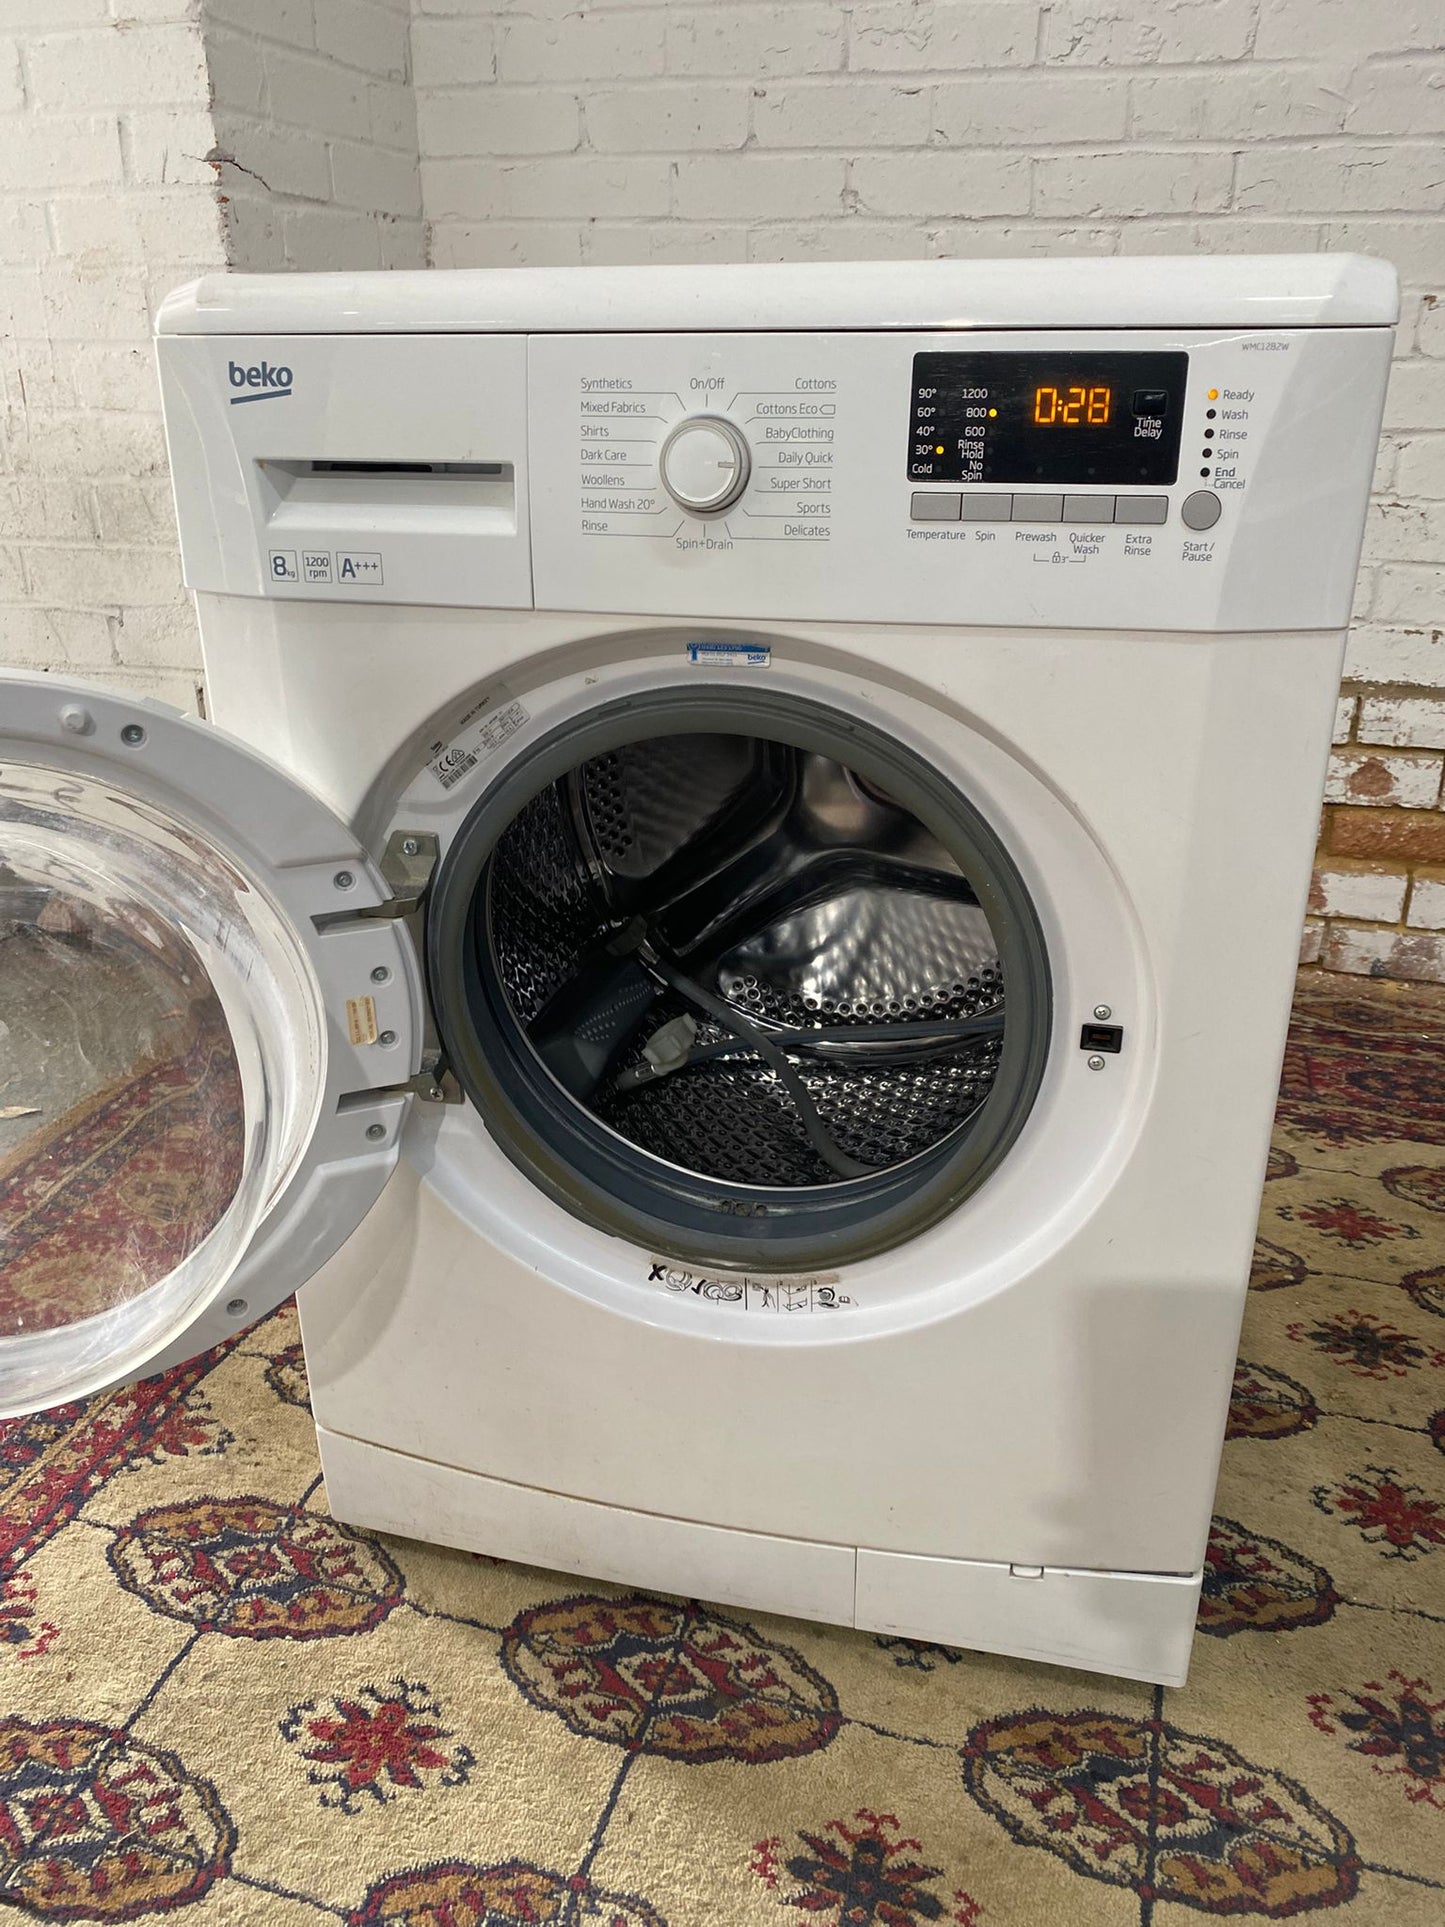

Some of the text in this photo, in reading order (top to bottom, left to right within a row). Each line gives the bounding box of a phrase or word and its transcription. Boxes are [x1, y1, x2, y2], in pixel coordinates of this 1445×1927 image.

[228, 361, 293, 388] beko
[581, 378, 632, 390] Synthetics
[690, 378, 725, 390] On/Off
[795, 379, 837, 390] Cottons
[918, 388, 937, 399] 90°
[961, 388, 988, 399] 1200
[1223, 389, 1255, 402] Ready
[581, 402, 646, 413] Mixed Fabrics
[756, 403, 818, 415] Cottons Eco
[1034, 387, 1111, 423] 0:28
[917, 407, 936, 418] 60°
[966, 407, 987, 418] 800
[1221, 409, 1249, 420] Wash
[1136, 417, 1161, 428] Time
[581, 426, 609, 437] Shirts
[916, 426, 935, 436] 40°
[964, 426, 986, 437] 600
[1134, 427, 1162, 439] Delay
[1219, 429, 1248, 440] Rinse
[915, 444, 934, 455] 30°
[957, 439, 985, 449] Rinse
[581, 450, 627, 461] Dark Care
[778, 452, 834, 465] Daily Quick
[961, 448, 984, 459] Hold
[1217, 449, 1239, 461] Spin
[912, 463, 933, 473] Cold
[969, 460, 983, 470] No
[961, 470, 983, 481] Spin
[1215, 467, 1236, 477] End
[581, 474, 625, 486] Woollens
[771, 478, 832, 490] Super Short
[1213, 479, 1246, 489] Cancel
[581, 498, 607, 509] Hand
[608, 499, 636, 510] Wash
[796, 502, 831, 514] Sports
[581, 520, 608, 531] Rinse
[784, 525, 831, 536] Delicates
[906, 529, 966, 541] Temperature
[975, 531, 996, 542] Spin
[1015, 532, 1057, 542] Prewash
[1069, 533, 1106, 544] Quicker
[1125, 534, 1152, 545] Extra
[676, 538, 734, 551] Spin+Drain
[1073, 544, 1099, 554] Wash
[1124, 545, 1151, 556] Rinse
[305, 557, 329, 568] 1200
[1182, 552, 1213, 562] Pause
[341, 558, 378, 578] A+++
[309, 569, 328, 579] rpm
